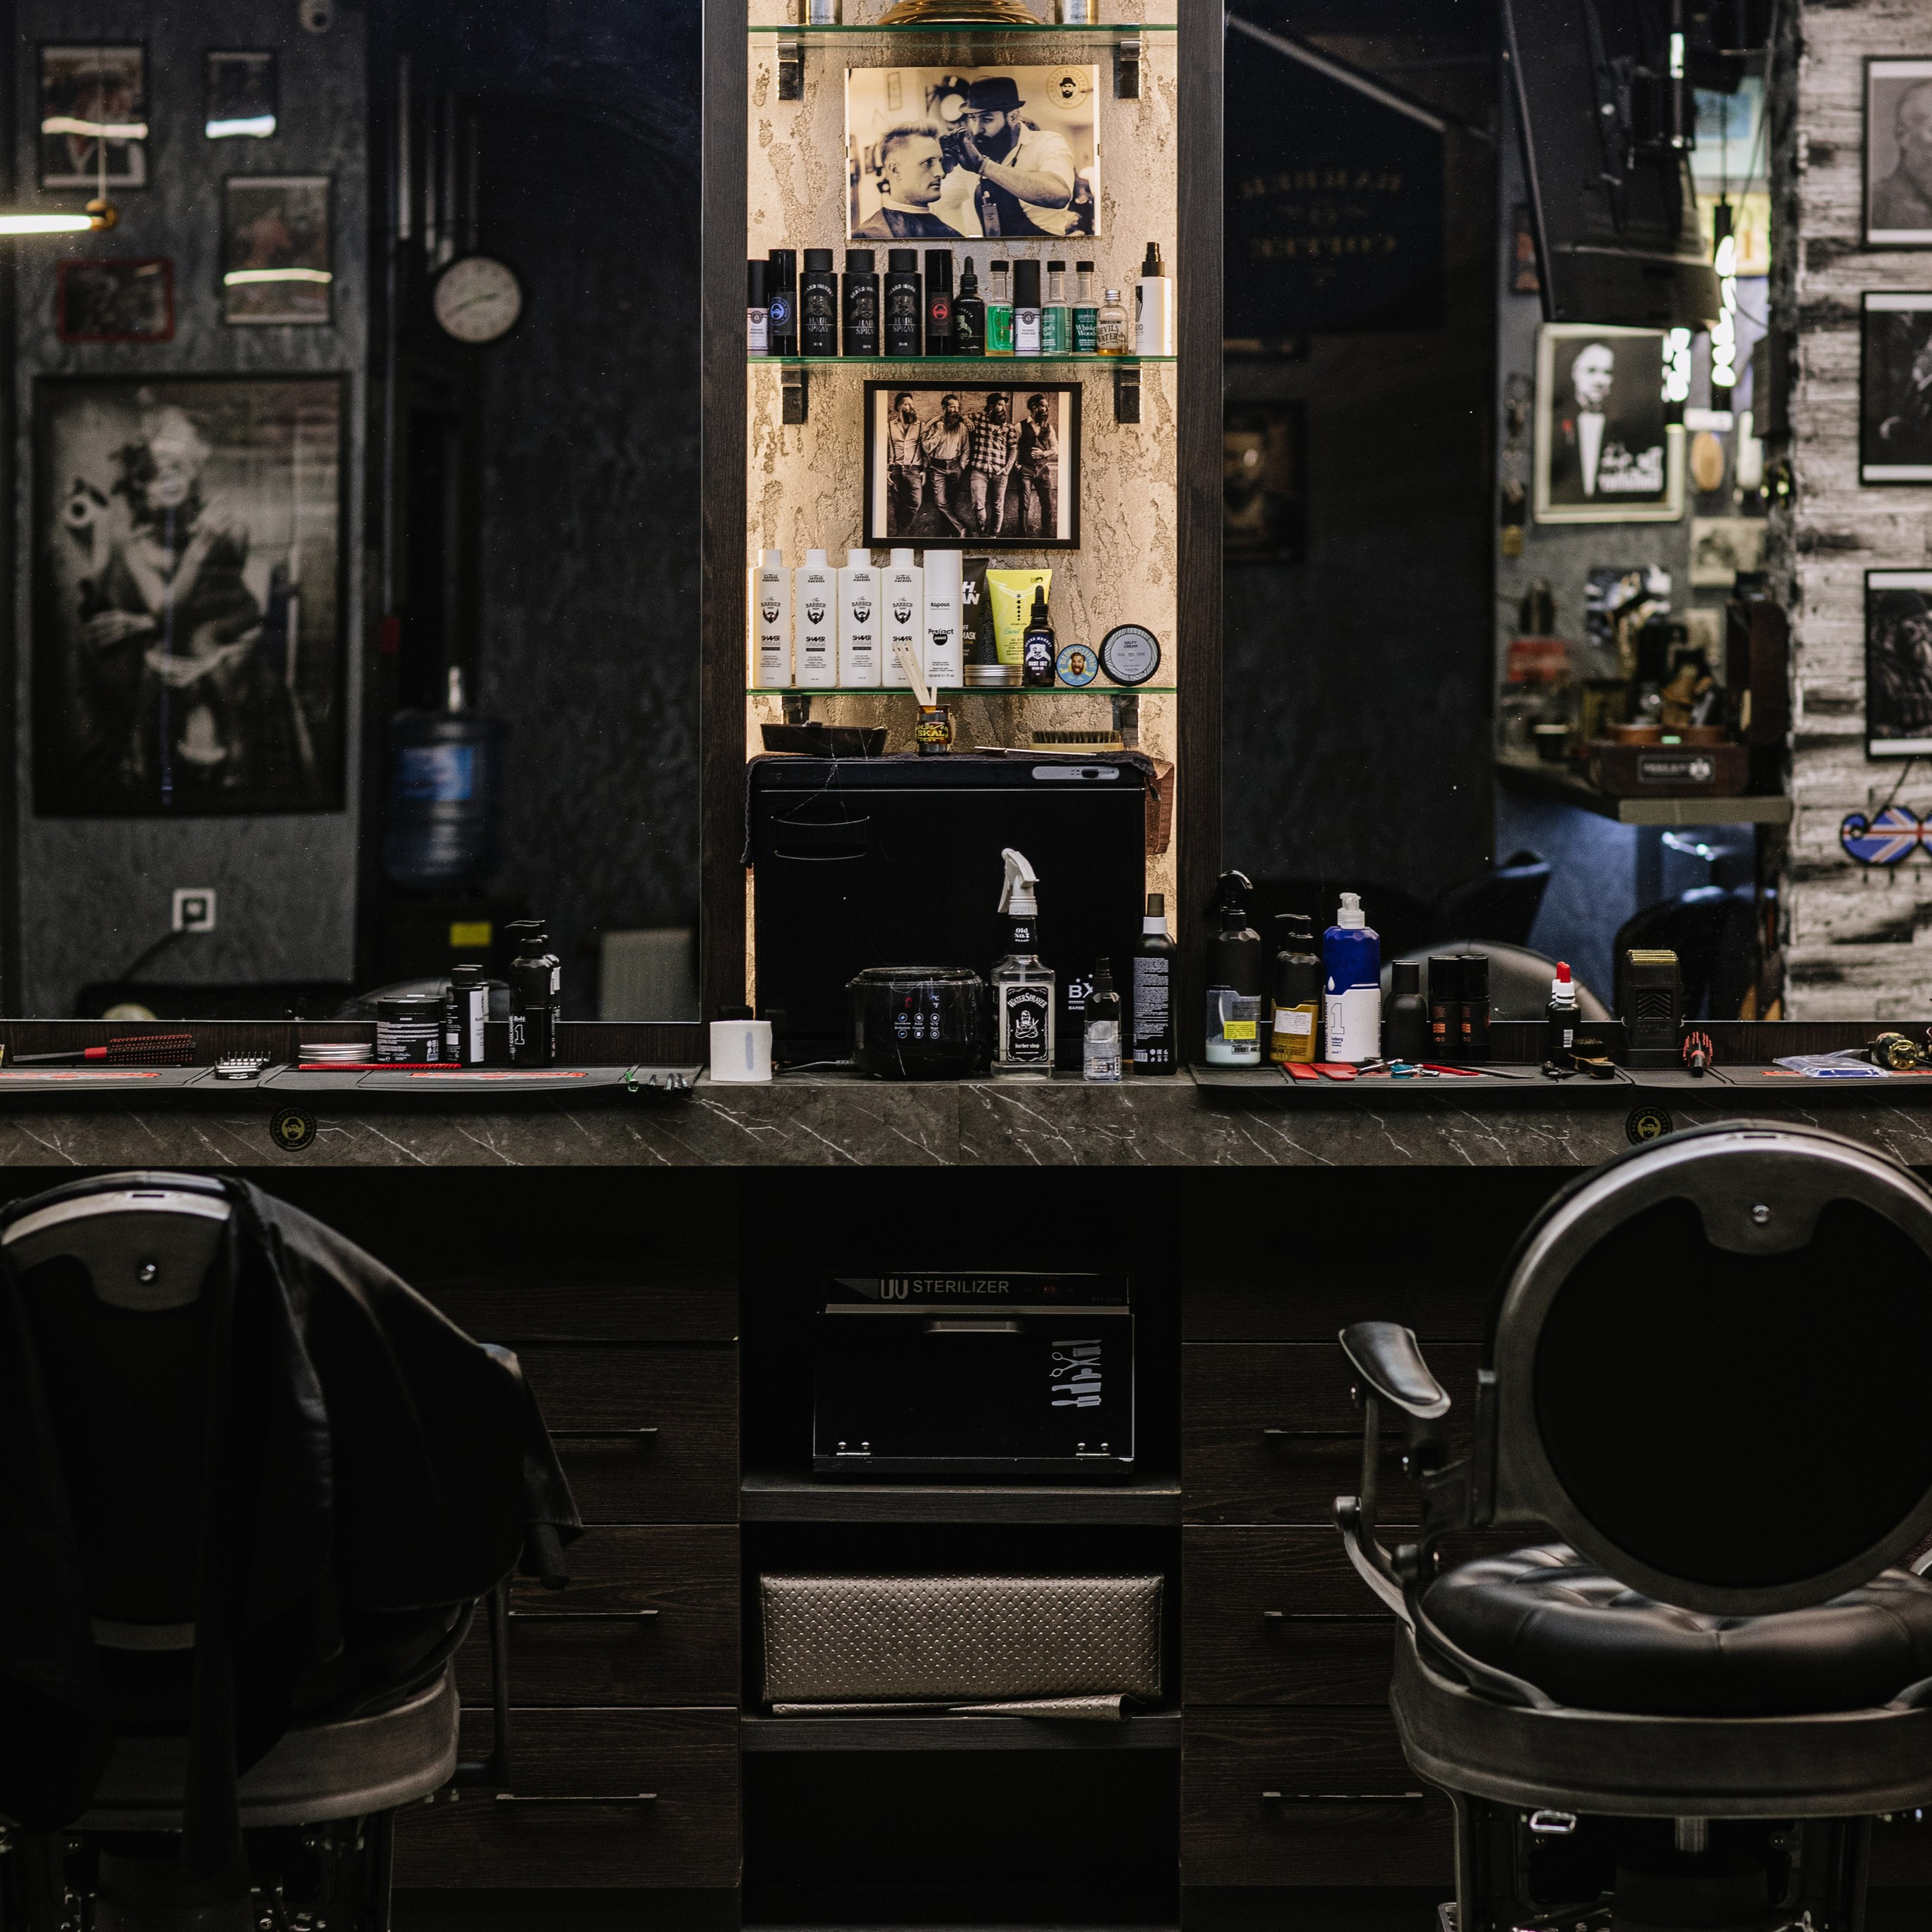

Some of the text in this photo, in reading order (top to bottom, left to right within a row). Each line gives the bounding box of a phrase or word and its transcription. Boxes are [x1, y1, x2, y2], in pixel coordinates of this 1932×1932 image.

[515, 1023, 525, 1045] 1
[880, 1278, 1010, 1300] UV STERILIZER
